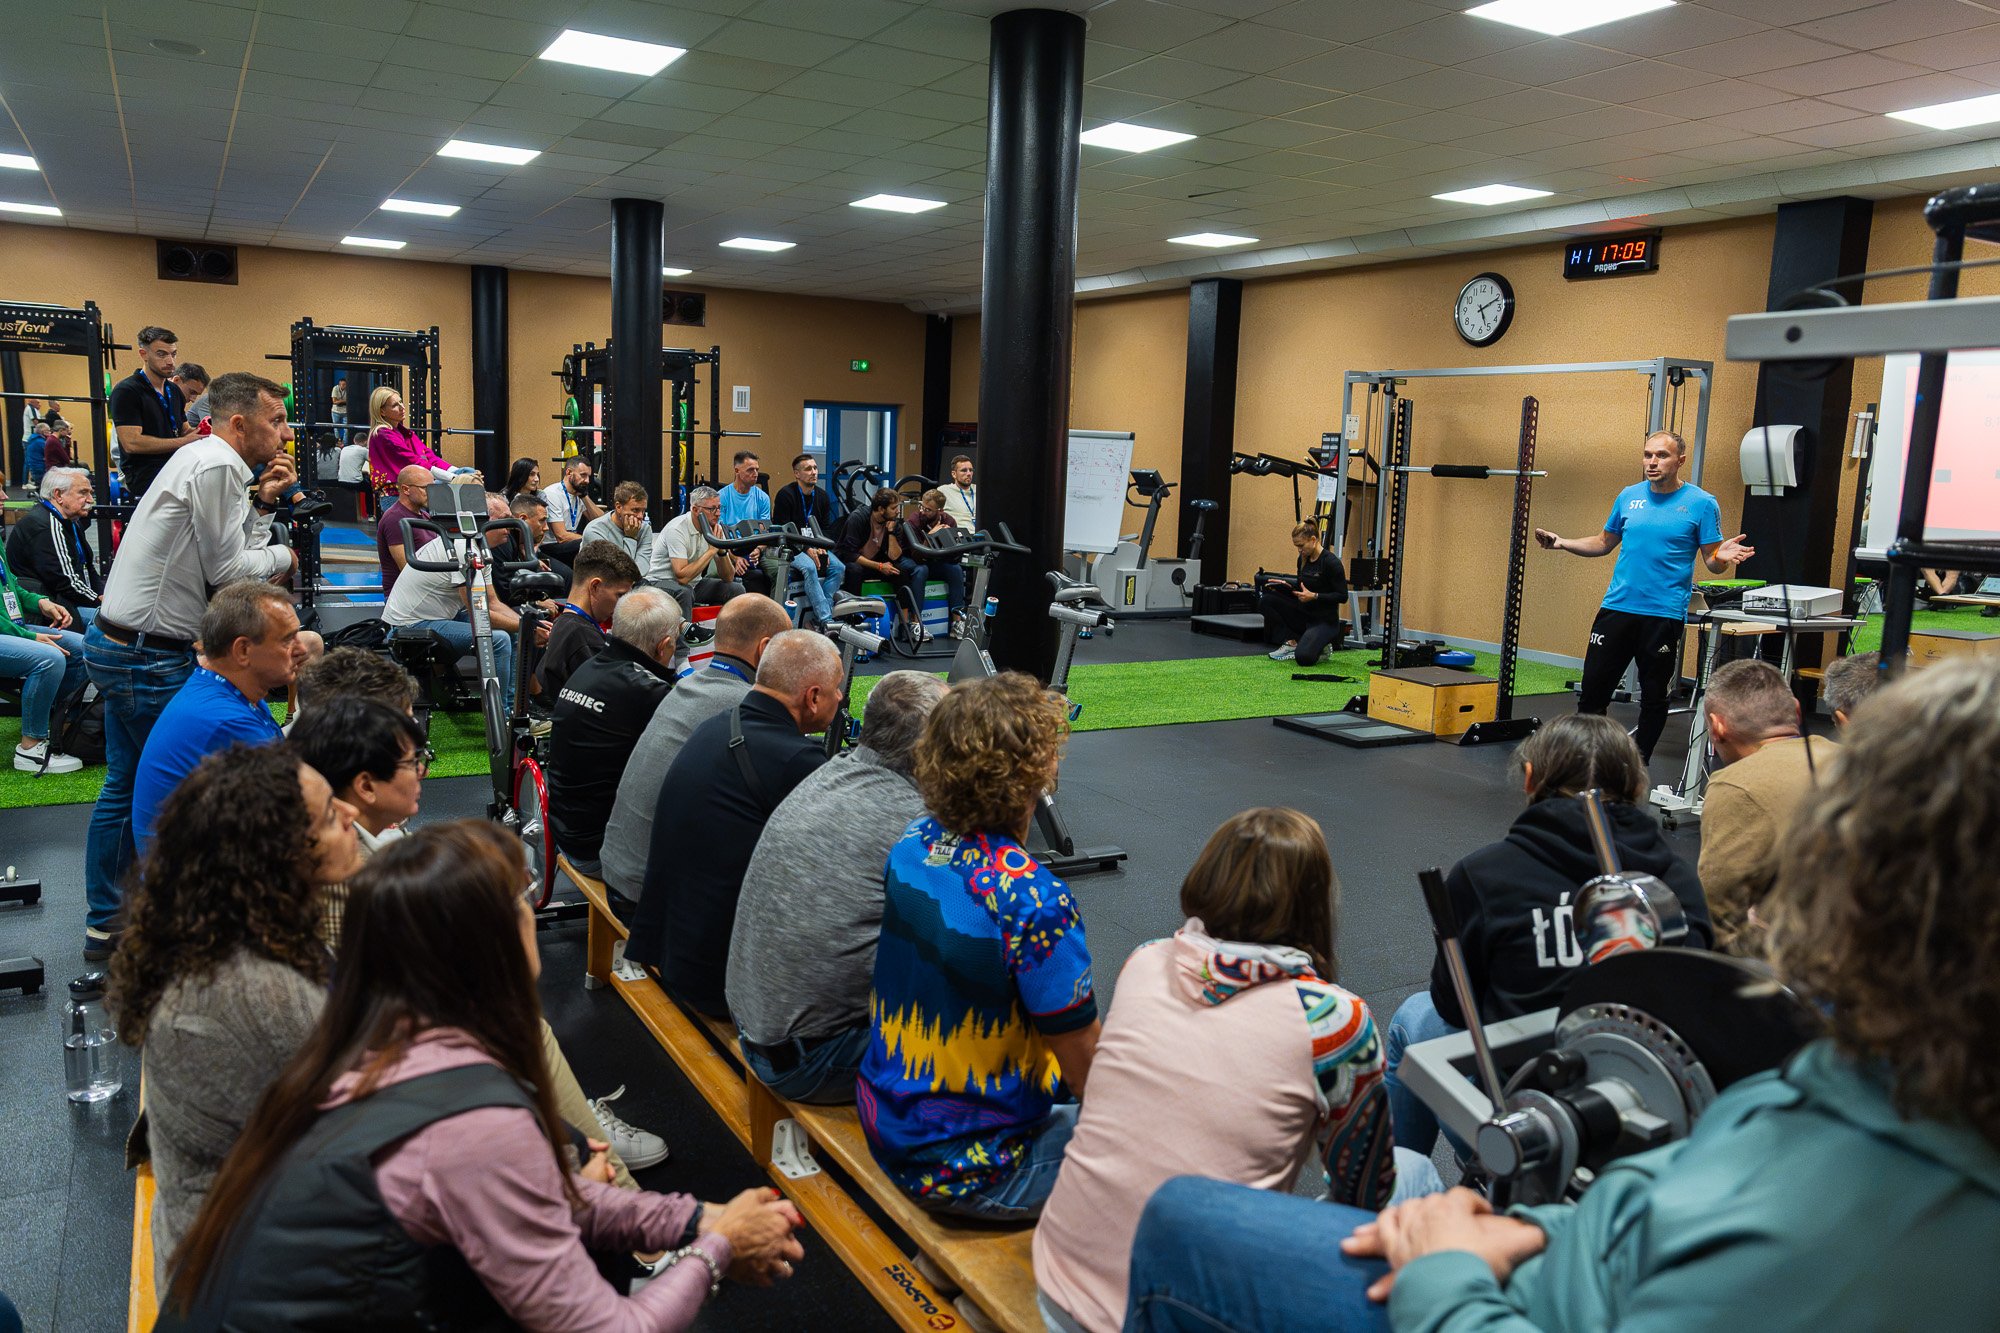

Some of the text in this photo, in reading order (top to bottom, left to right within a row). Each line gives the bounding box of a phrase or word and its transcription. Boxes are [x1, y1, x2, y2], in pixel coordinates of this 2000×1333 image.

[1602, 241, 1646, 262] 17:09
[1480, 284, 1487, 293] 12
[1466, 296, 1473, 304] 10
[1462, 306, 1468, 315] 9
[1496, 303, 1502, 312] 3
[1464, 317, 1470, 326] 8
[1493, 315, 1498, 323] 4
[0, 320, 50, 336] UST7GYM
[1470, 324, 1475, 332] 7
[1477, 325, 1483, 334] 6
[1486, 323, 1492, 331] 5
[1629, 499, 1647, 510] STC
[1589, 632, 1605, 646] STC
[565, 689, 606, 713] RUSIEC
